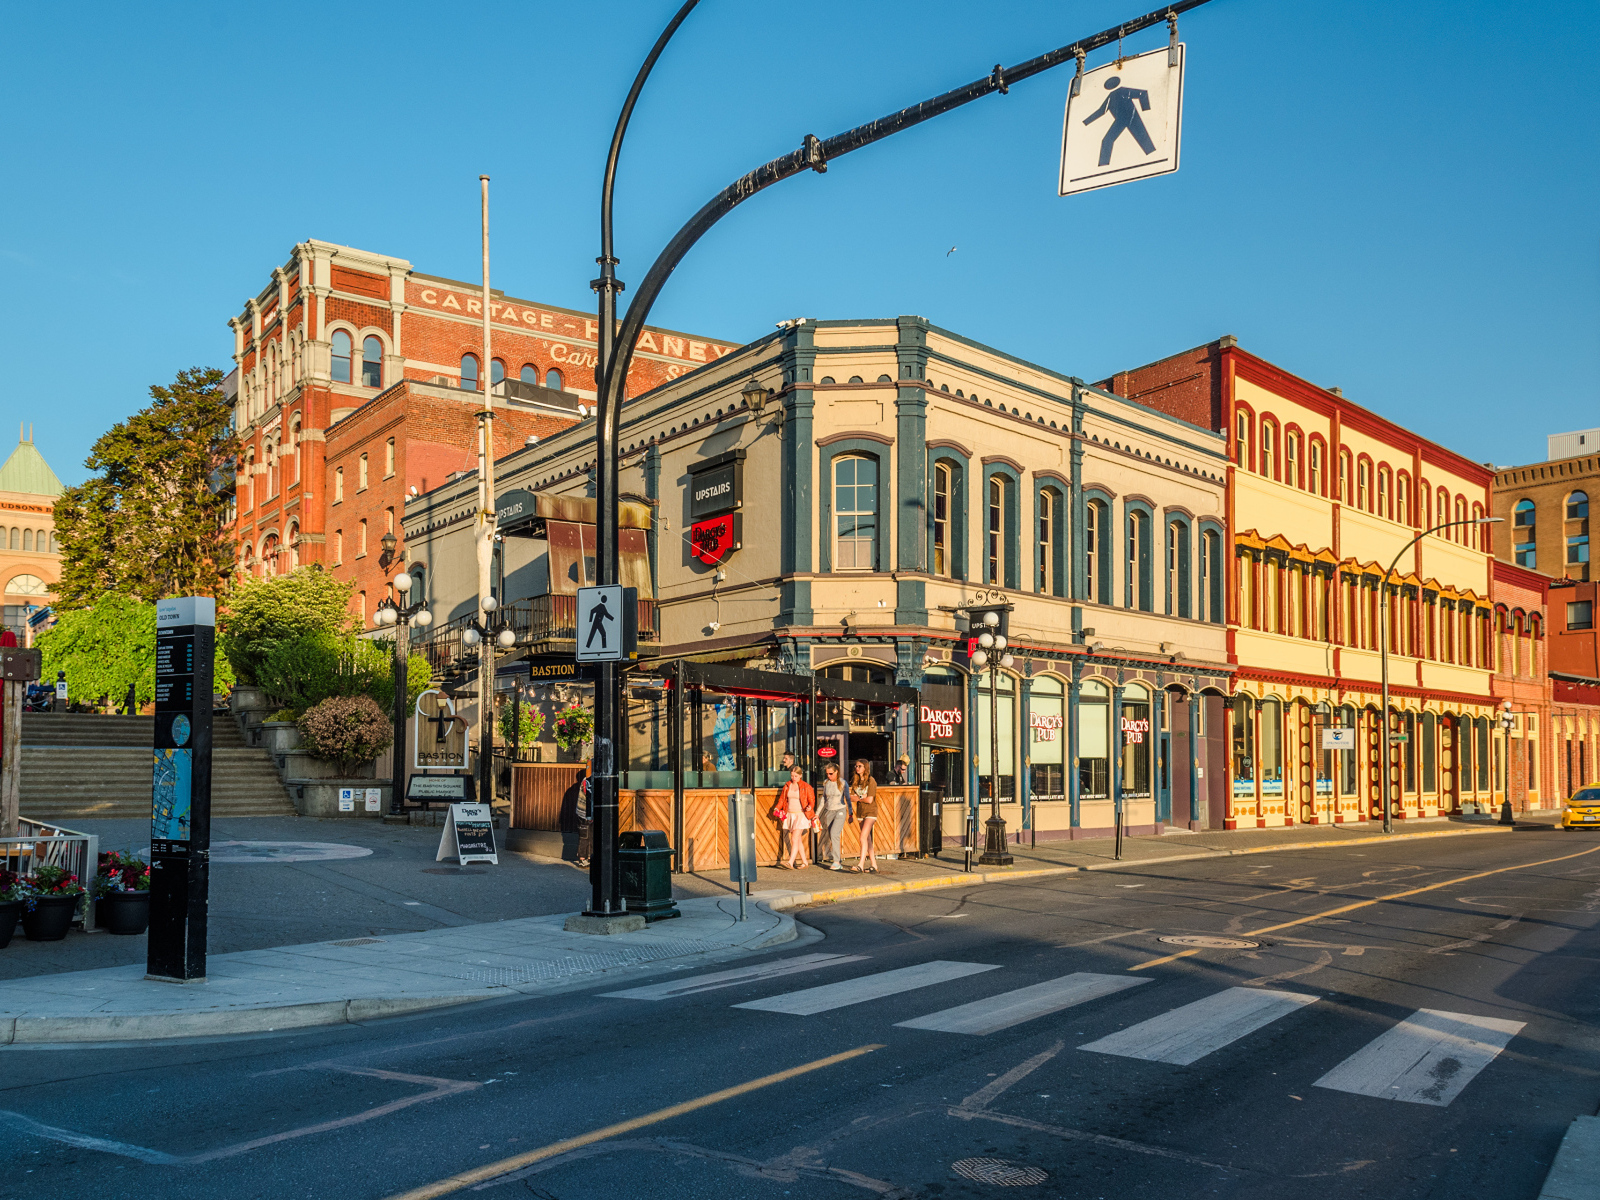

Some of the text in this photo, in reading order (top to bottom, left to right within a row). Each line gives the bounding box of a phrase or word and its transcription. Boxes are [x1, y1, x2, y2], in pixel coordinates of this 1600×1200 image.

[421, 290, 553, 328] CARTAGE
[585, 320, 732, 361] HANEY
[695, 481, 731, 501] UPSTAIRS
[532, 664, 575, 677] BASTION
[921, 705, 962, 725] DARCY'S
[1029, 712, 1062, 729] DARCY'S
[929, 722, 953, 739] PUB
[1121, 716, 1149, 733] DARCY'S
[1036, 728, 1056, 742] PUB
[1126, 731, 1143, 744] PUB
[418, 752, 464, 760] BASTION
